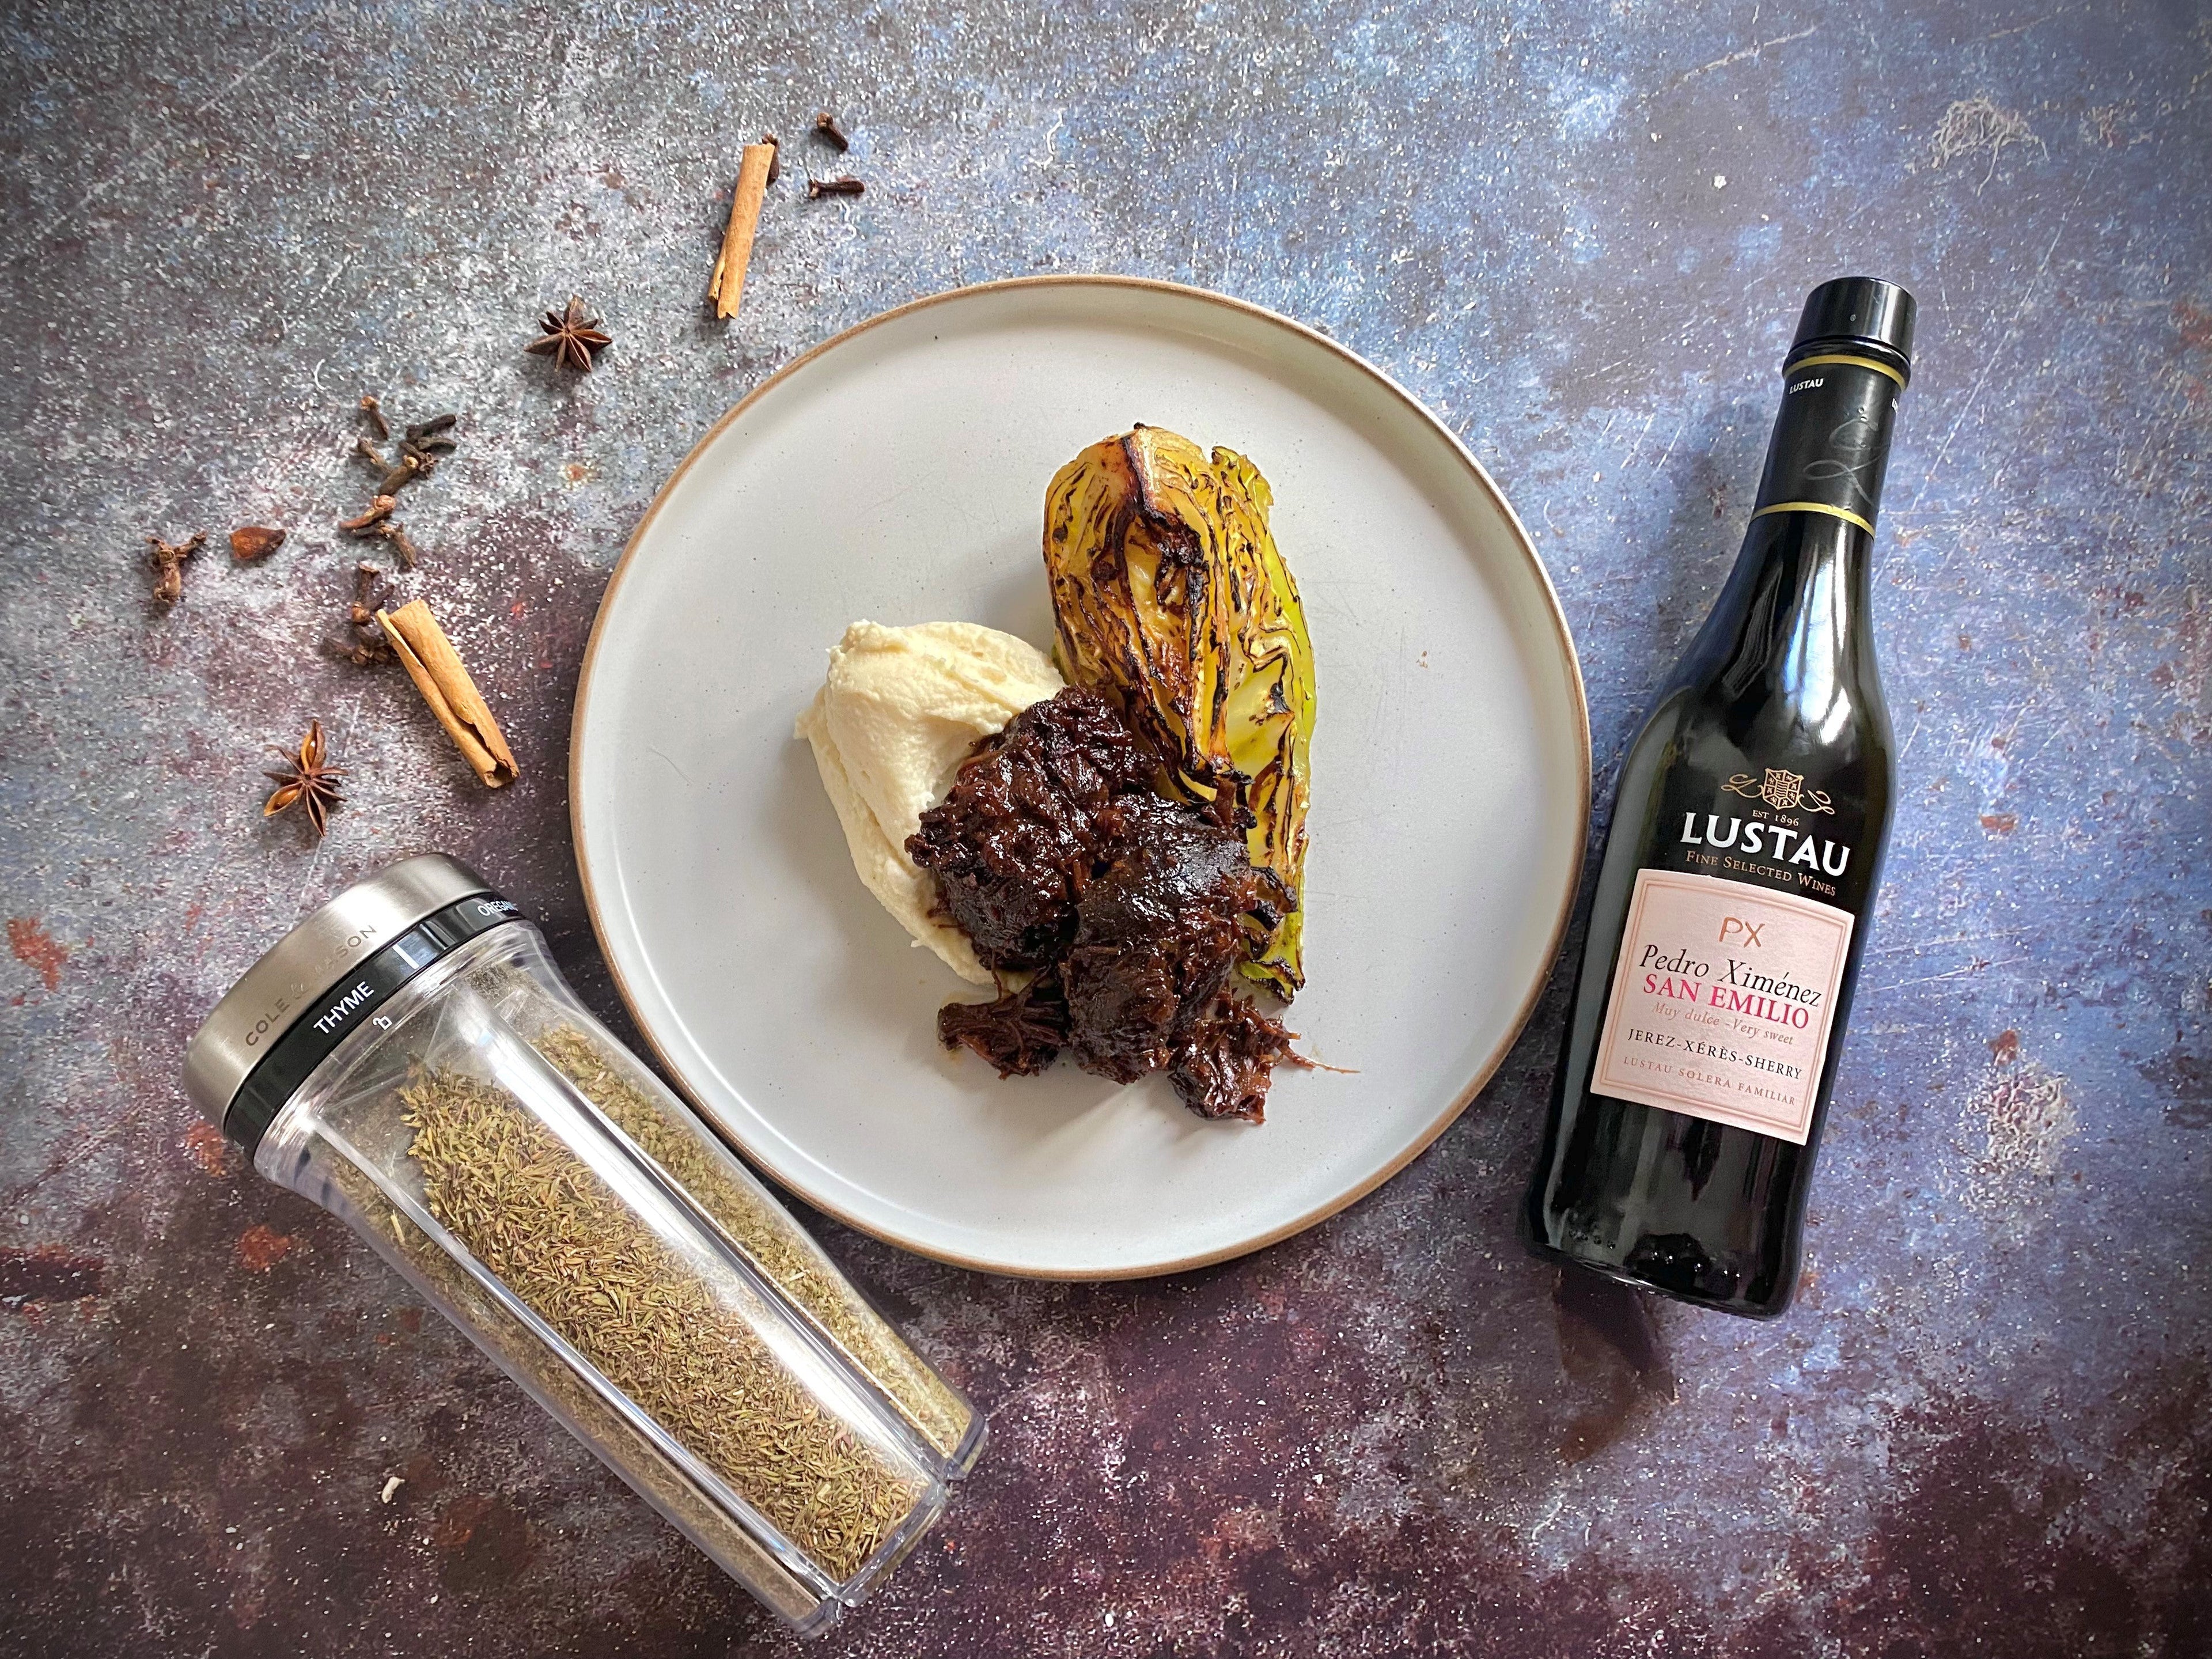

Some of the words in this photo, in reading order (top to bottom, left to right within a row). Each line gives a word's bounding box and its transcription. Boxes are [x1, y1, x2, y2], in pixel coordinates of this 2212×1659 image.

[1789, 378, 1823, 394] LUSTAU
[1752, 809, 1769, 819] EST
[1775, 815, 1800, 827] 1896
[1680, 812, 1850, 876] LUSTAU
[1686, 850, 1718, 866] FINE
[1723, 857, 1792, 882] SELECTED
[1798, 872, 1836, 896] WINES
[477, 900, 518, 916] OREGAN
[1718, 917, 1766, 948] PX
[1639, 945, 1709, 978] Pedro
[1717, 959, 1822, 1007] Ximénez
[246, 998, 290, 1046] COLE
[313, 982, 374, 1033] THYME
[1643, 974, 1701, 1002] SAN
[1708, 986, 1809, 1029] EMILIO
[1652, 1002, 1680, 1019] Muy
[1684, 1009, 1720, 1026] dulce
[1764, 1030, 1794, 1045] sweet
[1627, 1029, 1802, 1080] JEREZ-XÉRÈS-SHERRY
[1624, 1056, 1672, 1073] LUSTAU
[1678, 1068, 1732, 1089] SOLERA
[1737, 1082, 1796, 1105] FAMILIAR
